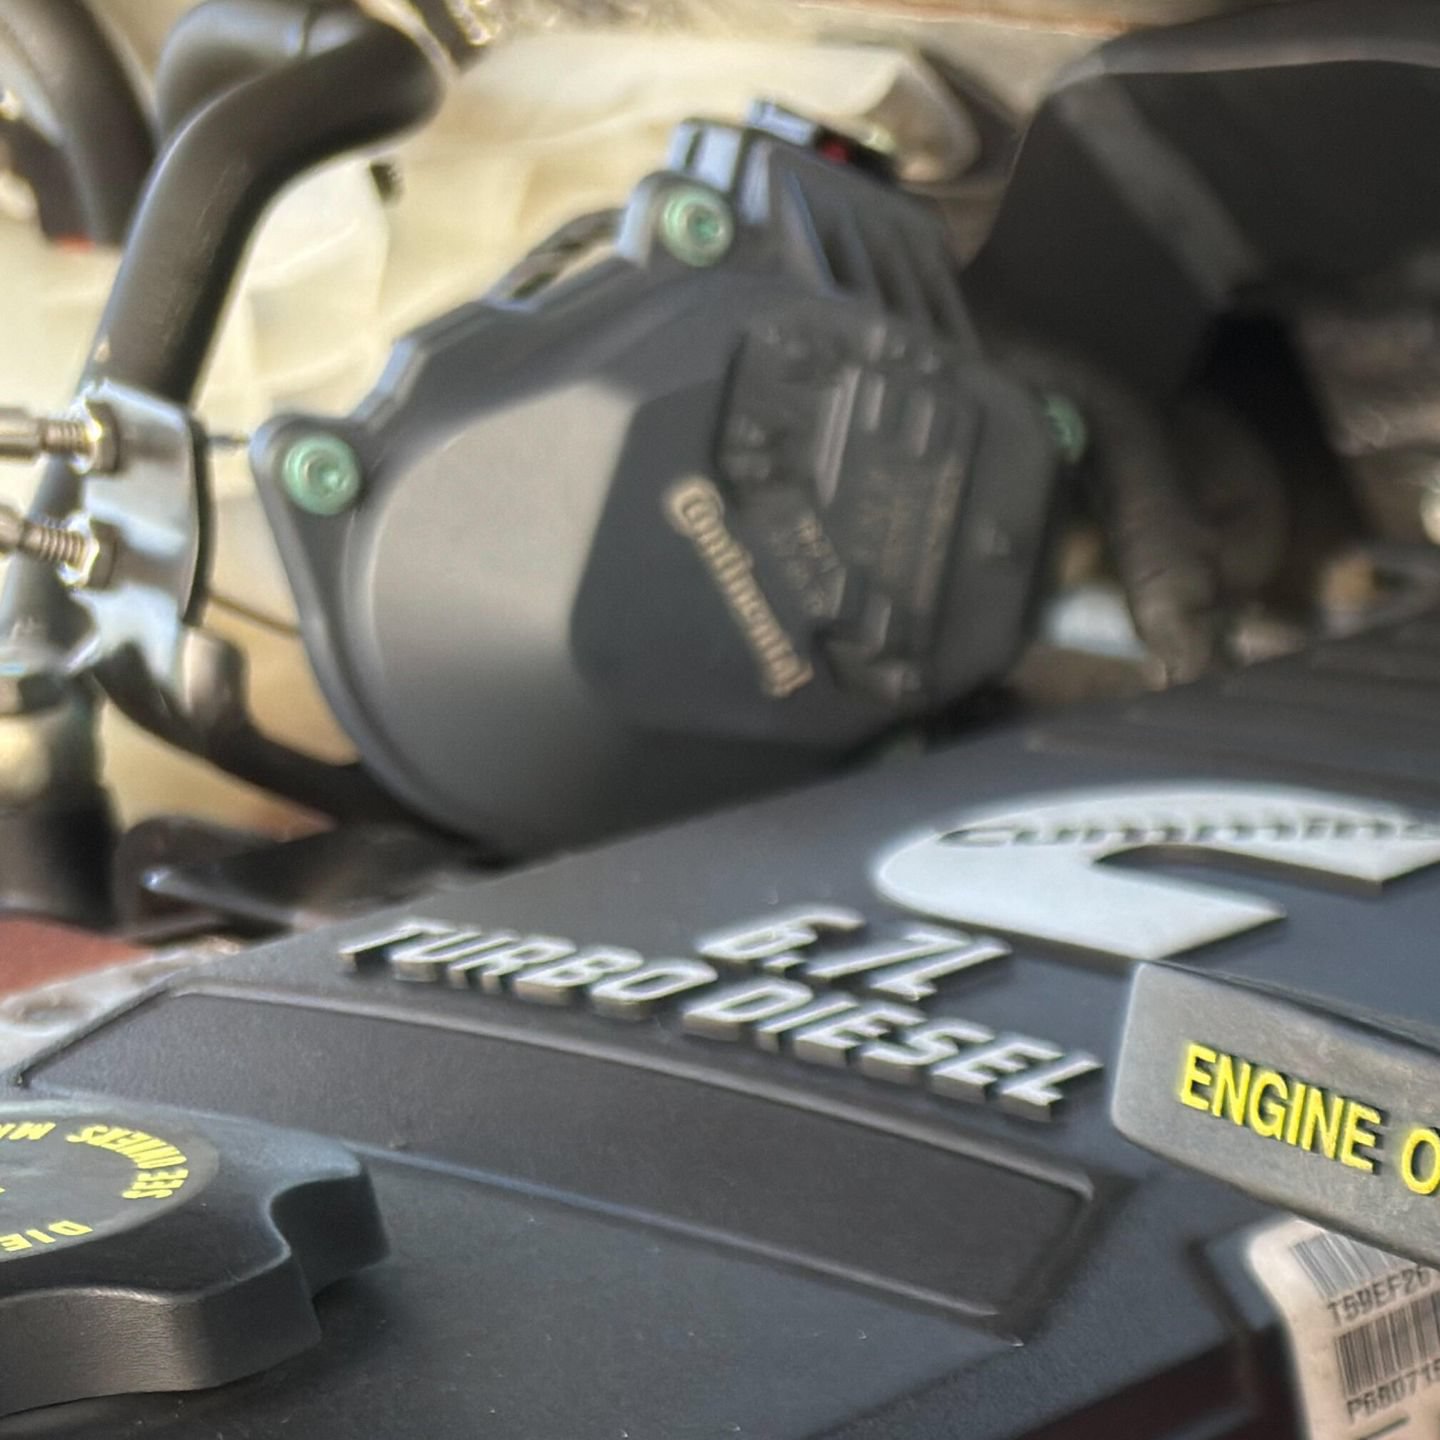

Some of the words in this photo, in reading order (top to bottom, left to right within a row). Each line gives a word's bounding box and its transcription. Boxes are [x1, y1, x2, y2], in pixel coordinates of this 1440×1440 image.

[701, 904, 1012, 1003] 6.7L
[338, 916, 719, 1019] TURBO
[682, 976, 1104, 1117] DIESEL
[1179, 1042, 1383, 1174] ENGINE
[121, 1167, 190, 1200] SEE
